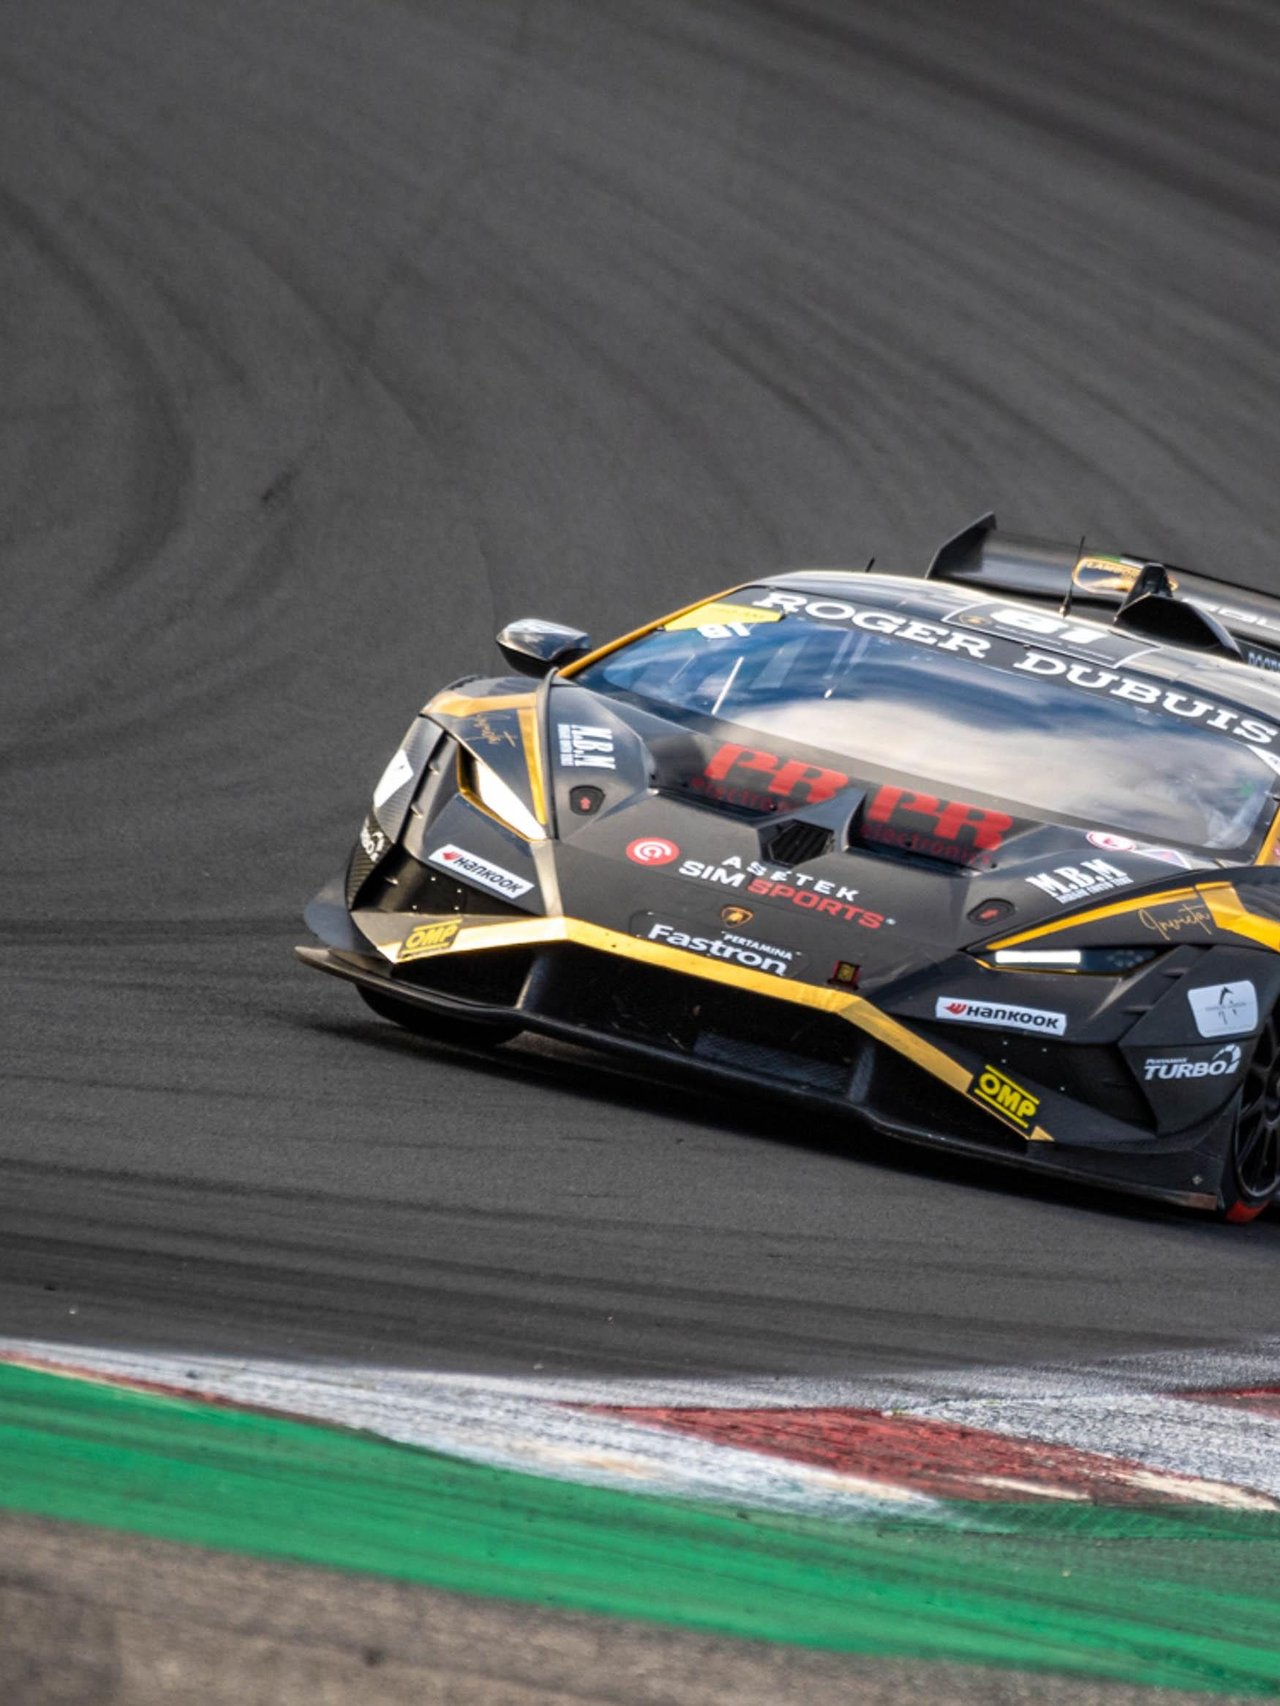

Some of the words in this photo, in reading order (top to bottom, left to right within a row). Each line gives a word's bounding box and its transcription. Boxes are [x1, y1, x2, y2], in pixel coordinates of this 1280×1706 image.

[990, 607, 1110, 645] 81
[753, 591, 991, 659] ROGER
[1013, 652, 1278, 744] DUBUIS
[703, 742, 849, 804] PR
[867, 783, 1014, 852] PR
[678, 860, 746, 888] SIM
[747, 878, 886, 929] SPORTS
[721, 855, 859, 902] ASETEK
[405, 923, 459, 949] OMP
[647, 923, 787, 976] Fastron
[722, 931, 793, 961] PERTAMINA
[1144, 1060, 1228, 1081] TURBO
[979, 1072, 1037, 1117] OMP
